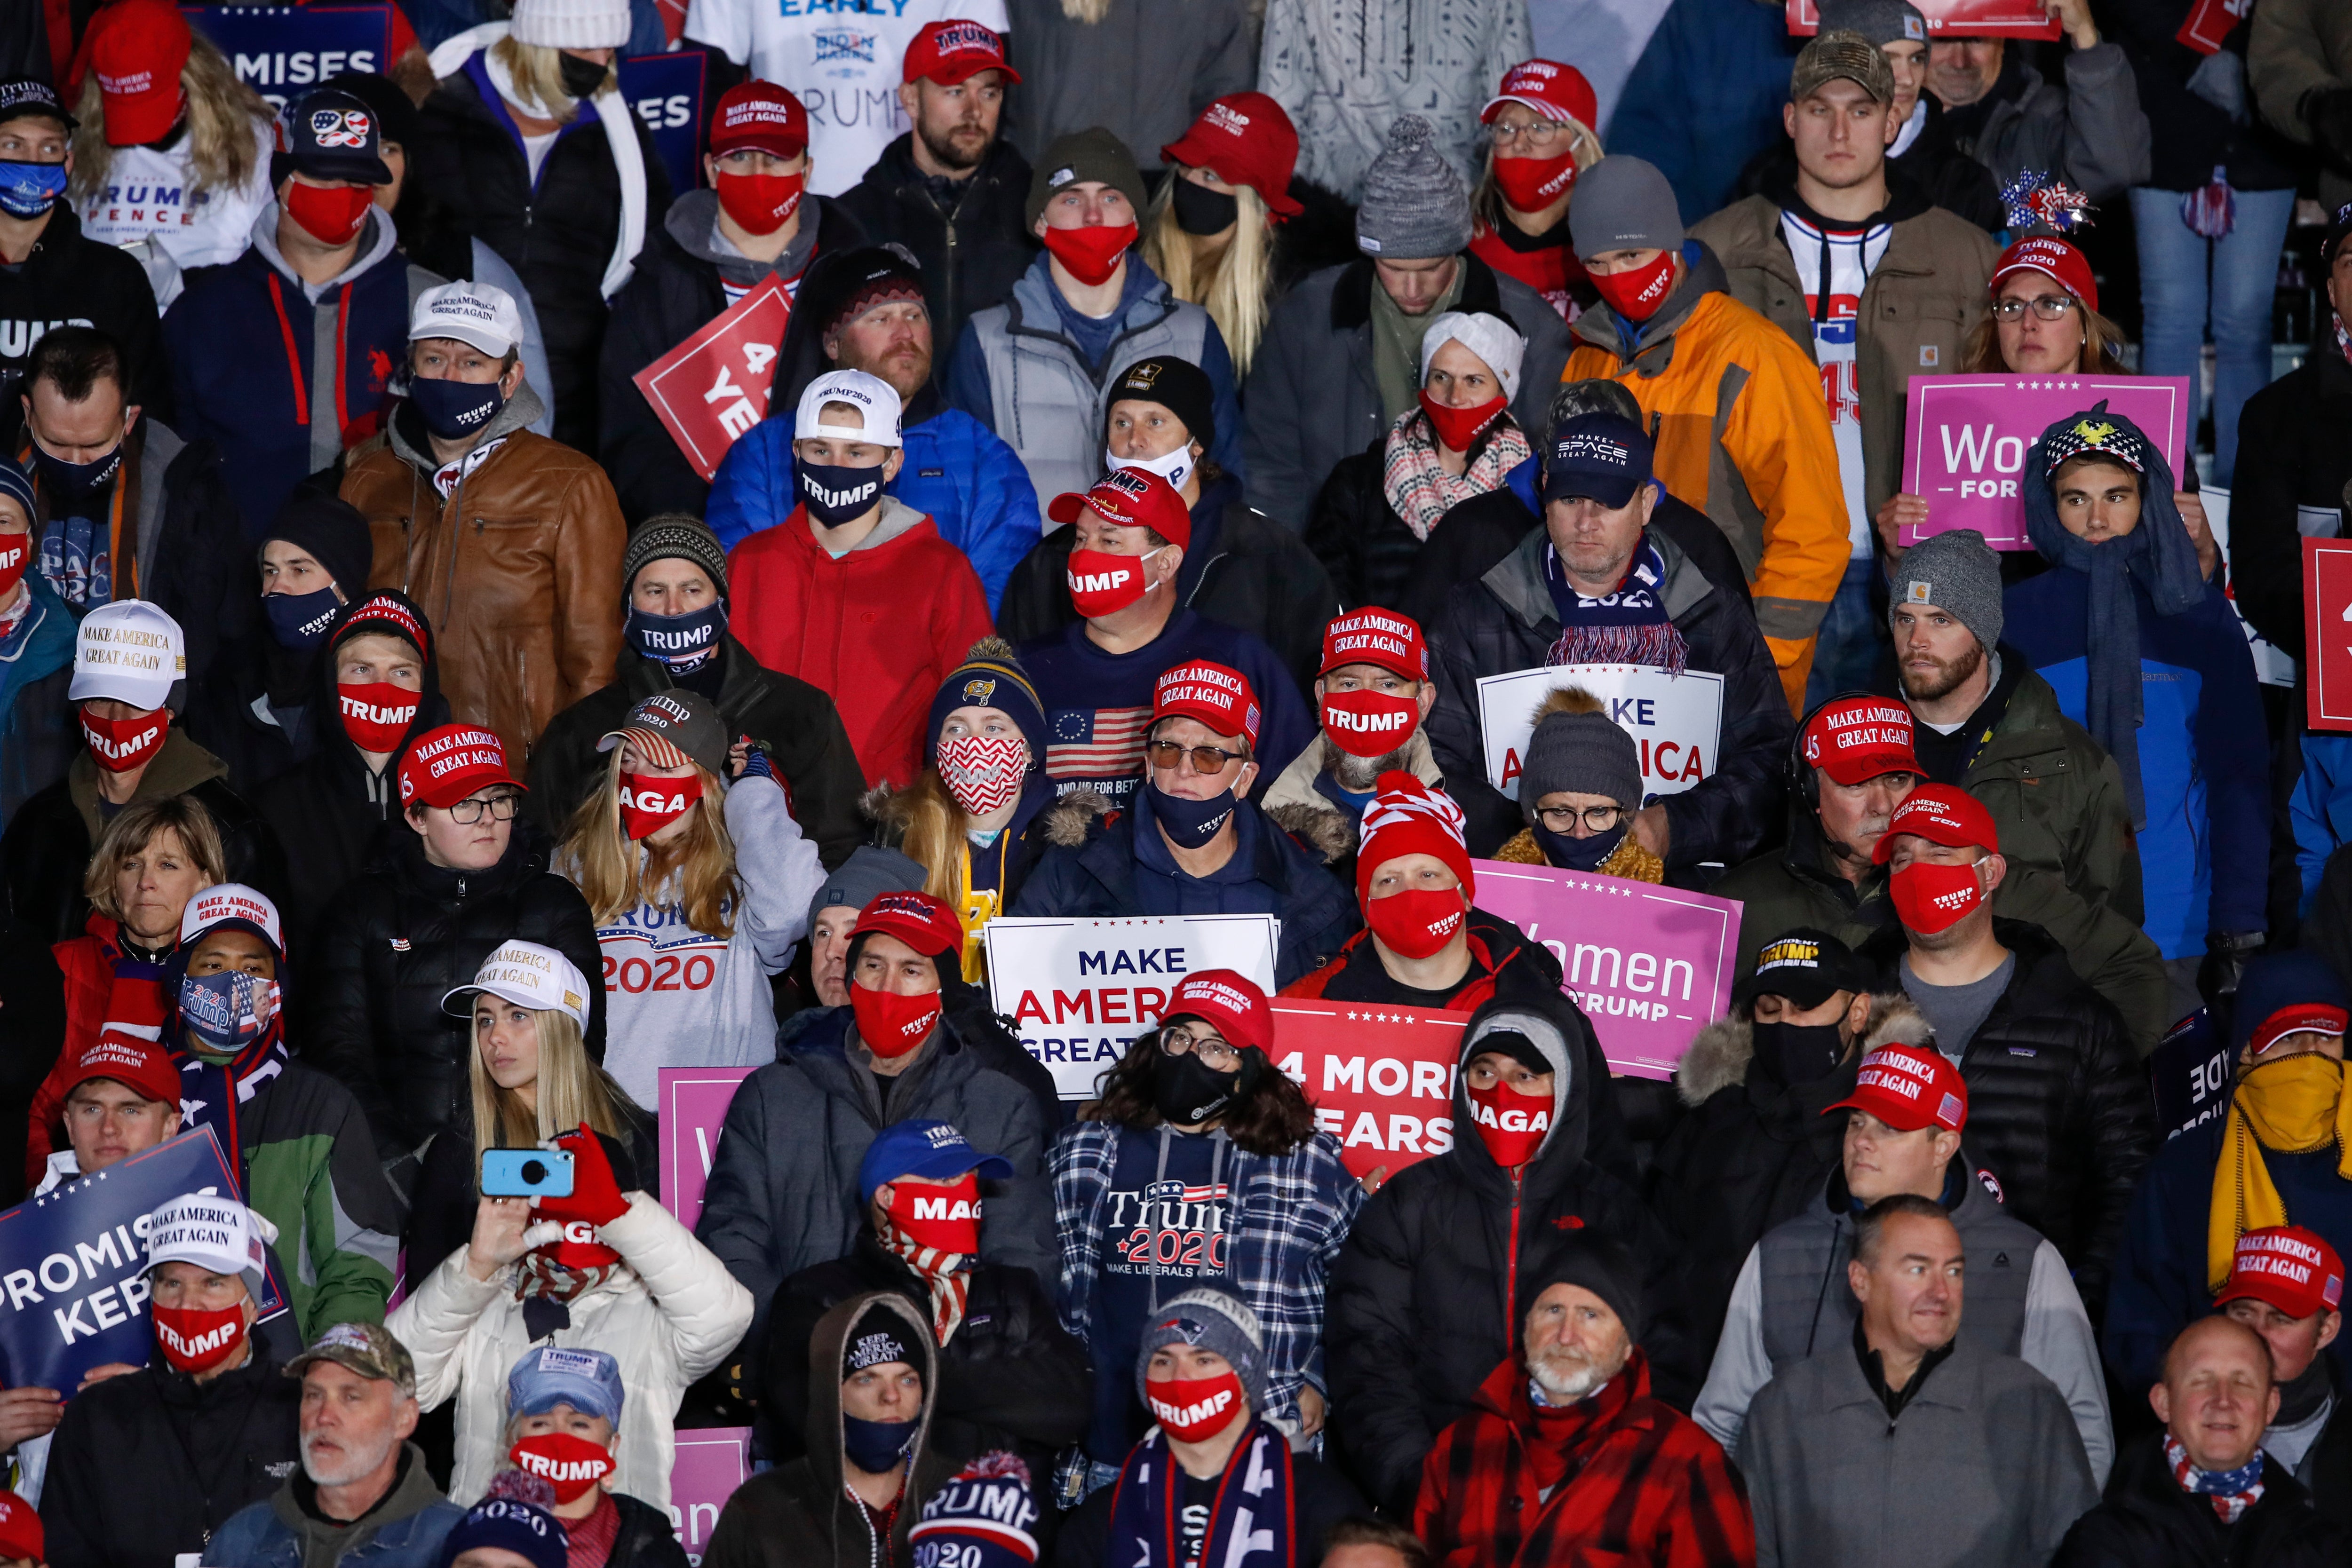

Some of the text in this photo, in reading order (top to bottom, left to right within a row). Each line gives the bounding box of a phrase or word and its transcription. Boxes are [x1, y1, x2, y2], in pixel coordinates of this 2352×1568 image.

[779, 0, 907, 17] EARLY
[935, 29, 997, 51] TRUMP
[235, 50, 375, 86] MISES
[1510, 81, 1545, 92] 2020
[726, 100, 787, 117] MAKE AMERICA
[726, 112, 786, 127] GREAT AGAIN
[798, 88, 908, 129] RUMP
[1538, 167, 1572, 194] TRUMP
[88, 209, 194, 227] PENCE
[2018, 240, 2066, 255] Trump
[2018, 254, 2056, 267] 2020
[1637, 269, 1667, 300] TRUMP
[430, 297, 496, 312] MAKE AMERICA
[463, 309, 493, 321] AGAIN
[742, 342, 777, 374] 4
[819, 388, 872, 405] TRUMP2020
[456, 401, 493, 421] TRUMP
[461, 409, 492, 425] PENCE
[1578, 434, 1606, 443] MAKE
[1558, 442, 1627, 459] SPACE
[1593, 452, 1626, 466] AGAIN
[803, 473, 877, 508] TRUMP
[1121, 487, 1140, 503] AGAIN
[1961, 480, 2018, 498] FOR
[1099, 507, 1133, 523] PRESIDENT
[299, 608, 336, 634] TRUMP
[305, 615, 334, 636] PENCE
[1329, 615, 1413, 642] MAKE AMERICA
[83, 626, 169, 651] MAKE AMERICA
[642, 625, 712, 649] TRUMP
[1335, 635, 1406, 657] GREAT AGAIN
[86, 648, 160, 671] GREAT AGAIN
[1159, 668, 1242, 696] MAKE AMERICA
[340, 696, 416, 725] TRUMP
[1162, 687, 1233, 711] GREAT AGAIN
[636, 713, 668, 728] 2020
[1327, 707, 1408, 732] TRUMP
[1827, 707, 1912, 730] MAKE AMERICA
[83, 720, 158, 759] TRUMP
[415, 731, 502, 763] MAKE AMERICA
[1805, 729, 1909, 760] 45 GREAT AGAIN
[430, 753, 469, 778] GREAT
[472, 749, 502, 768] AGAIN
[951, 765, 1001, 784] TRUMP
[1094, 781, 1112, 794] FOR
[1909, 799, 1950, 811] AMERICA
[1914, 805, 1944, 814] AGAIN
[1930, 816, 1961, 828] CCM
[197, 896, 268, 919] MAKE AMERICA
[1933, 887, 1973, 905] TRUMP
[1939, 895, 1971, 910] PENCE
[199, 908, 266, 928] GREAT AGAIN!
[892, 909, 931, 925] PRESIDENT
[1427, 911, 1460, 932] TRUMP
[1431, 919, 1458, 936] PENCE
[1760, 943, 1819, 966] TRUMP
[1761, 938, 1819, 952] PRESIDENT
[496, 949, 551, 973] AMERICA
[1079, 948, 1187, 976] MAKE
[498, 969, 540, 989] AGAIN
[604, 955, 715, 994] 2020
[181, 978, 229, 1030] Trump
[193, 984, 227, 1008] 2020
[1182, 981, 1252, 1010] MAKE AMERICA
[1184, 989, 1244, 1014] GREAT AGAIN
[1569, 990, 1669, 1022] TRUMP
[901, 1010, 935, 1034] TRUMP
[80, 1042, 148, 1062] MAKE AMERICA
[80, 1053, 142, 1068] GREAT AGAIN
[1275, 1052, 1305, 1084] 4
[1877, 1051, 1936, 1085] AMERICA
[1878, 1072, 1922, 1100] AGAIN
[1314, 1108, 1454, 1155] EARS
[151, 1208, 238, 1232] MAKE AMERICA
[153, 1229, 229, 1250] GREAT AGAIN
[1128, 1229, 1224, 1269] 2020
[2264, 1235, 2321, 1267] AMERICA
[1107, 1263, 1193, 1278] MAKE LIBERALS
[2268, 1258, 2312, 1284] AGAIN
[53, 1278, 150, 1347] KEP
[158, 1320, 236, 1358] TRUMP
[857, 1332, 889, 1348] KEEP
[549, 1353, 591, 1364] TRUMP
[848, 1341, 904, 1365] AMERICA
[1149, 1389, 1232, 1428] TRUMP
[519, 1450, 607, 1481] TRUMP
